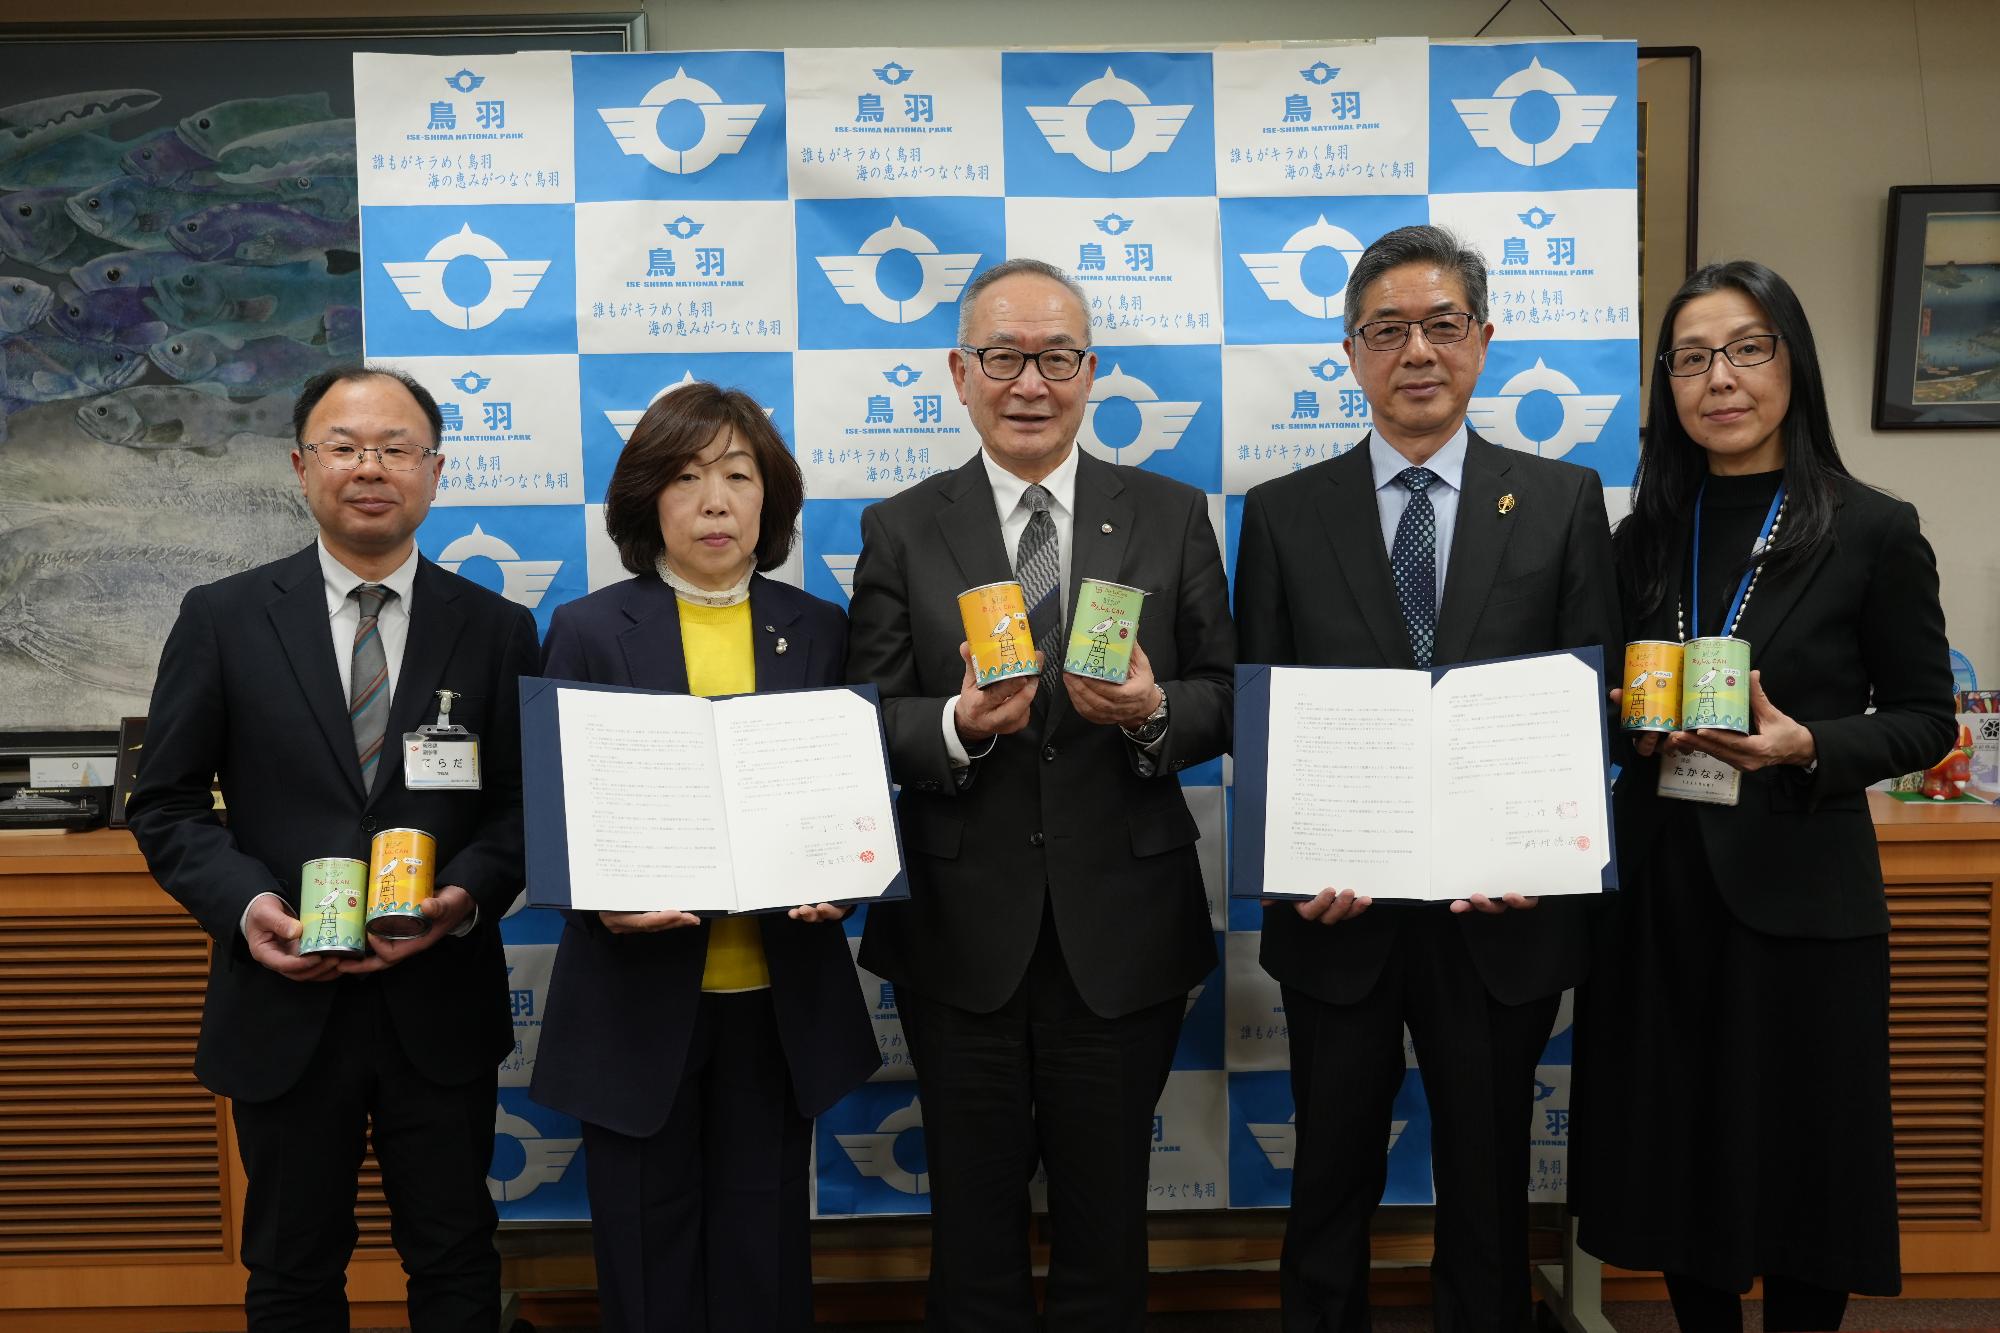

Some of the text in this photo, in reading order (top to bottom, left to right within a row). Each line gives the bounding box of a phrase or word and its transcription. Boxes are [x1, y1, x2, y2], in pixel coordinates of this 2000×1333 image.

[427, 99, 505, 130] 鳥羽
[855, 94, 934, 123] 鳥羽
[1281, 92, 1360, 124] 鳥羽
[1263, 126, 1310, 134] ISE-SHIMA
[372, 152, 493, 171] 誰もがキラめく鳥羽
[802, 146, 921, 164] 誰もがキラめく鳥羽
[1230, 144, 1348, 163] 誰もがキラめく鳥羽
[427, 170, 560, 190] 海の恵みがつなぐ鳥羽
[856, 163, 989, 182] 海の恵みがつなぐ鳥羽
[1285, 162, 1415, 179] 海の恵みがつなぐ鳥羽
[1077, 242, 1153, 272] 鳥羽
[1502, 237, 1576, 266] 鳥羽
[647, 247, 725, 277] 鳥羽
[1490, 288, 1563, 306] キラめく鳥羽
[593, 301, 714, 319] 誰もがキラめく鳥羽
[1503, 306, 1629, 324] 海の恵みがつなぐ鳥羽
[649, 318, 781, 336] 海の恵みがつなぐ鳥羽
[1092, 312, 1209, 329] の恵みがつなぐ鳥羽
[866, 394, 943, 424] 鳥羽
[1290, 390, 1368, 418] 鳥羽
[811, 447, 928, 464] 誰もがキラめく鳥羽
[422, 758, 463, 769] てらだ
[1674, 766, 1725, 781] たかなみ
